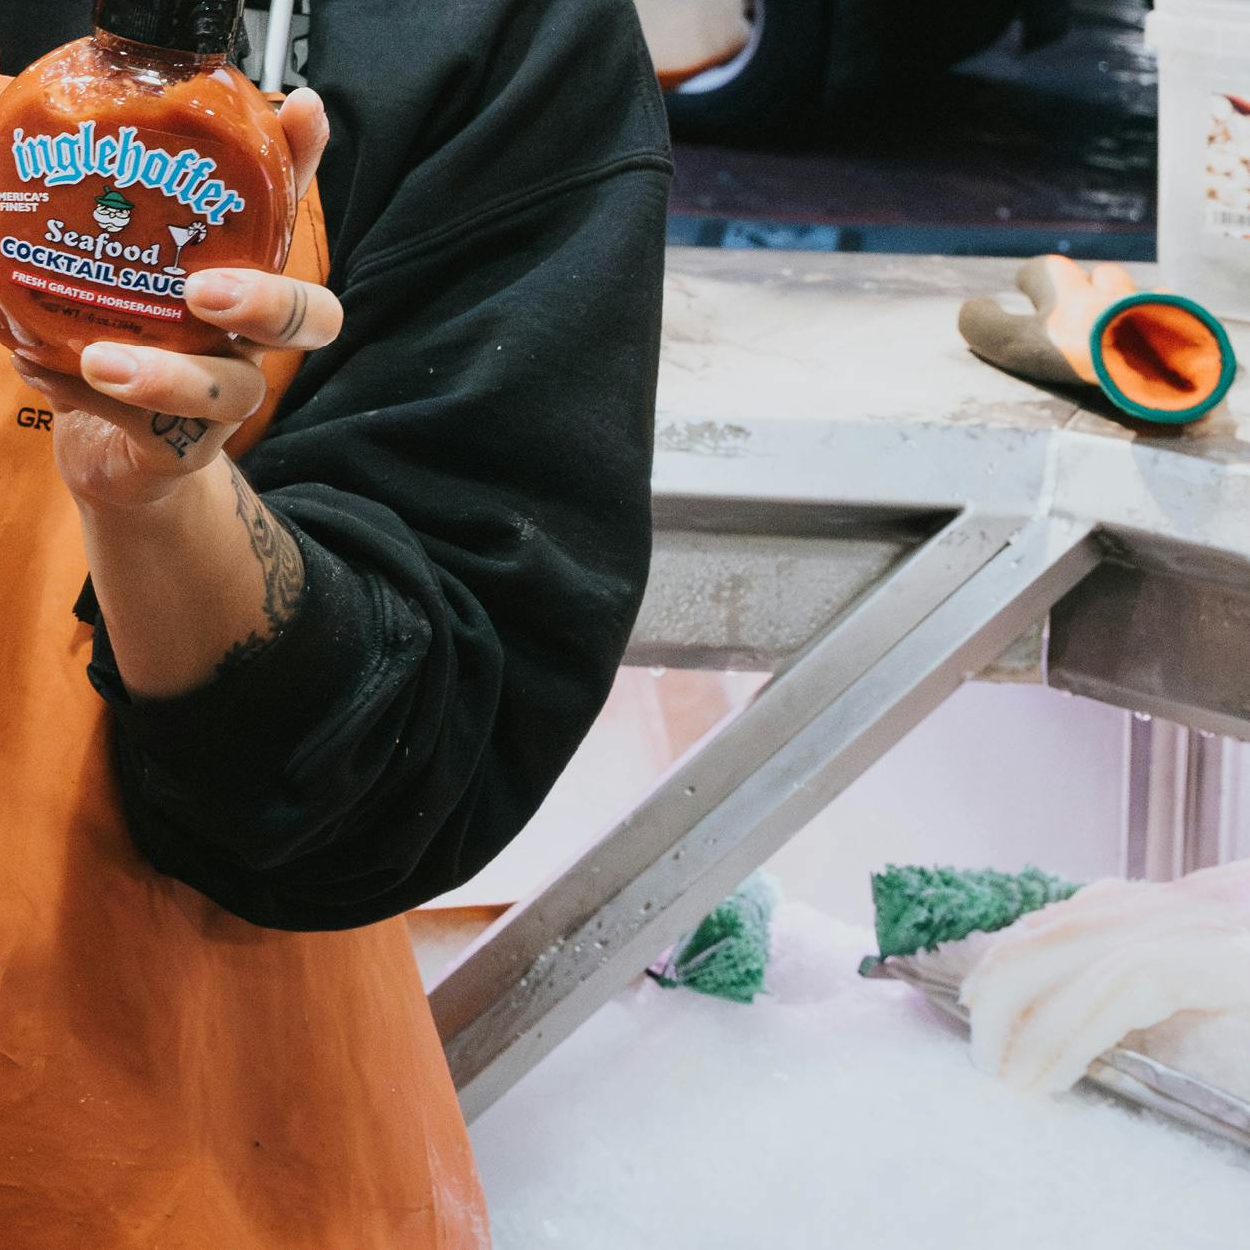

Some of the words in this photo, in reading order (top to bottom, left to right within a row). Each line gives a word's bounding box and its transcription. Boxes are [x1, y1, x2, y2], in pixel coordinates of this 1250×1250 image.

[12, 120, 245, 225] inglehoffer
[0, 202, 39, 212] FINEST
[45, 219, 160, 266] Seafood
[0, 237, 117, 286] COCKTAIL
[119, 267, 187, 298] SAUC
[12, 271, 47, 289] FRESH
[49, 282, 95, 301] GRATED
[96, 294, 182, 319] HORSERADISH
